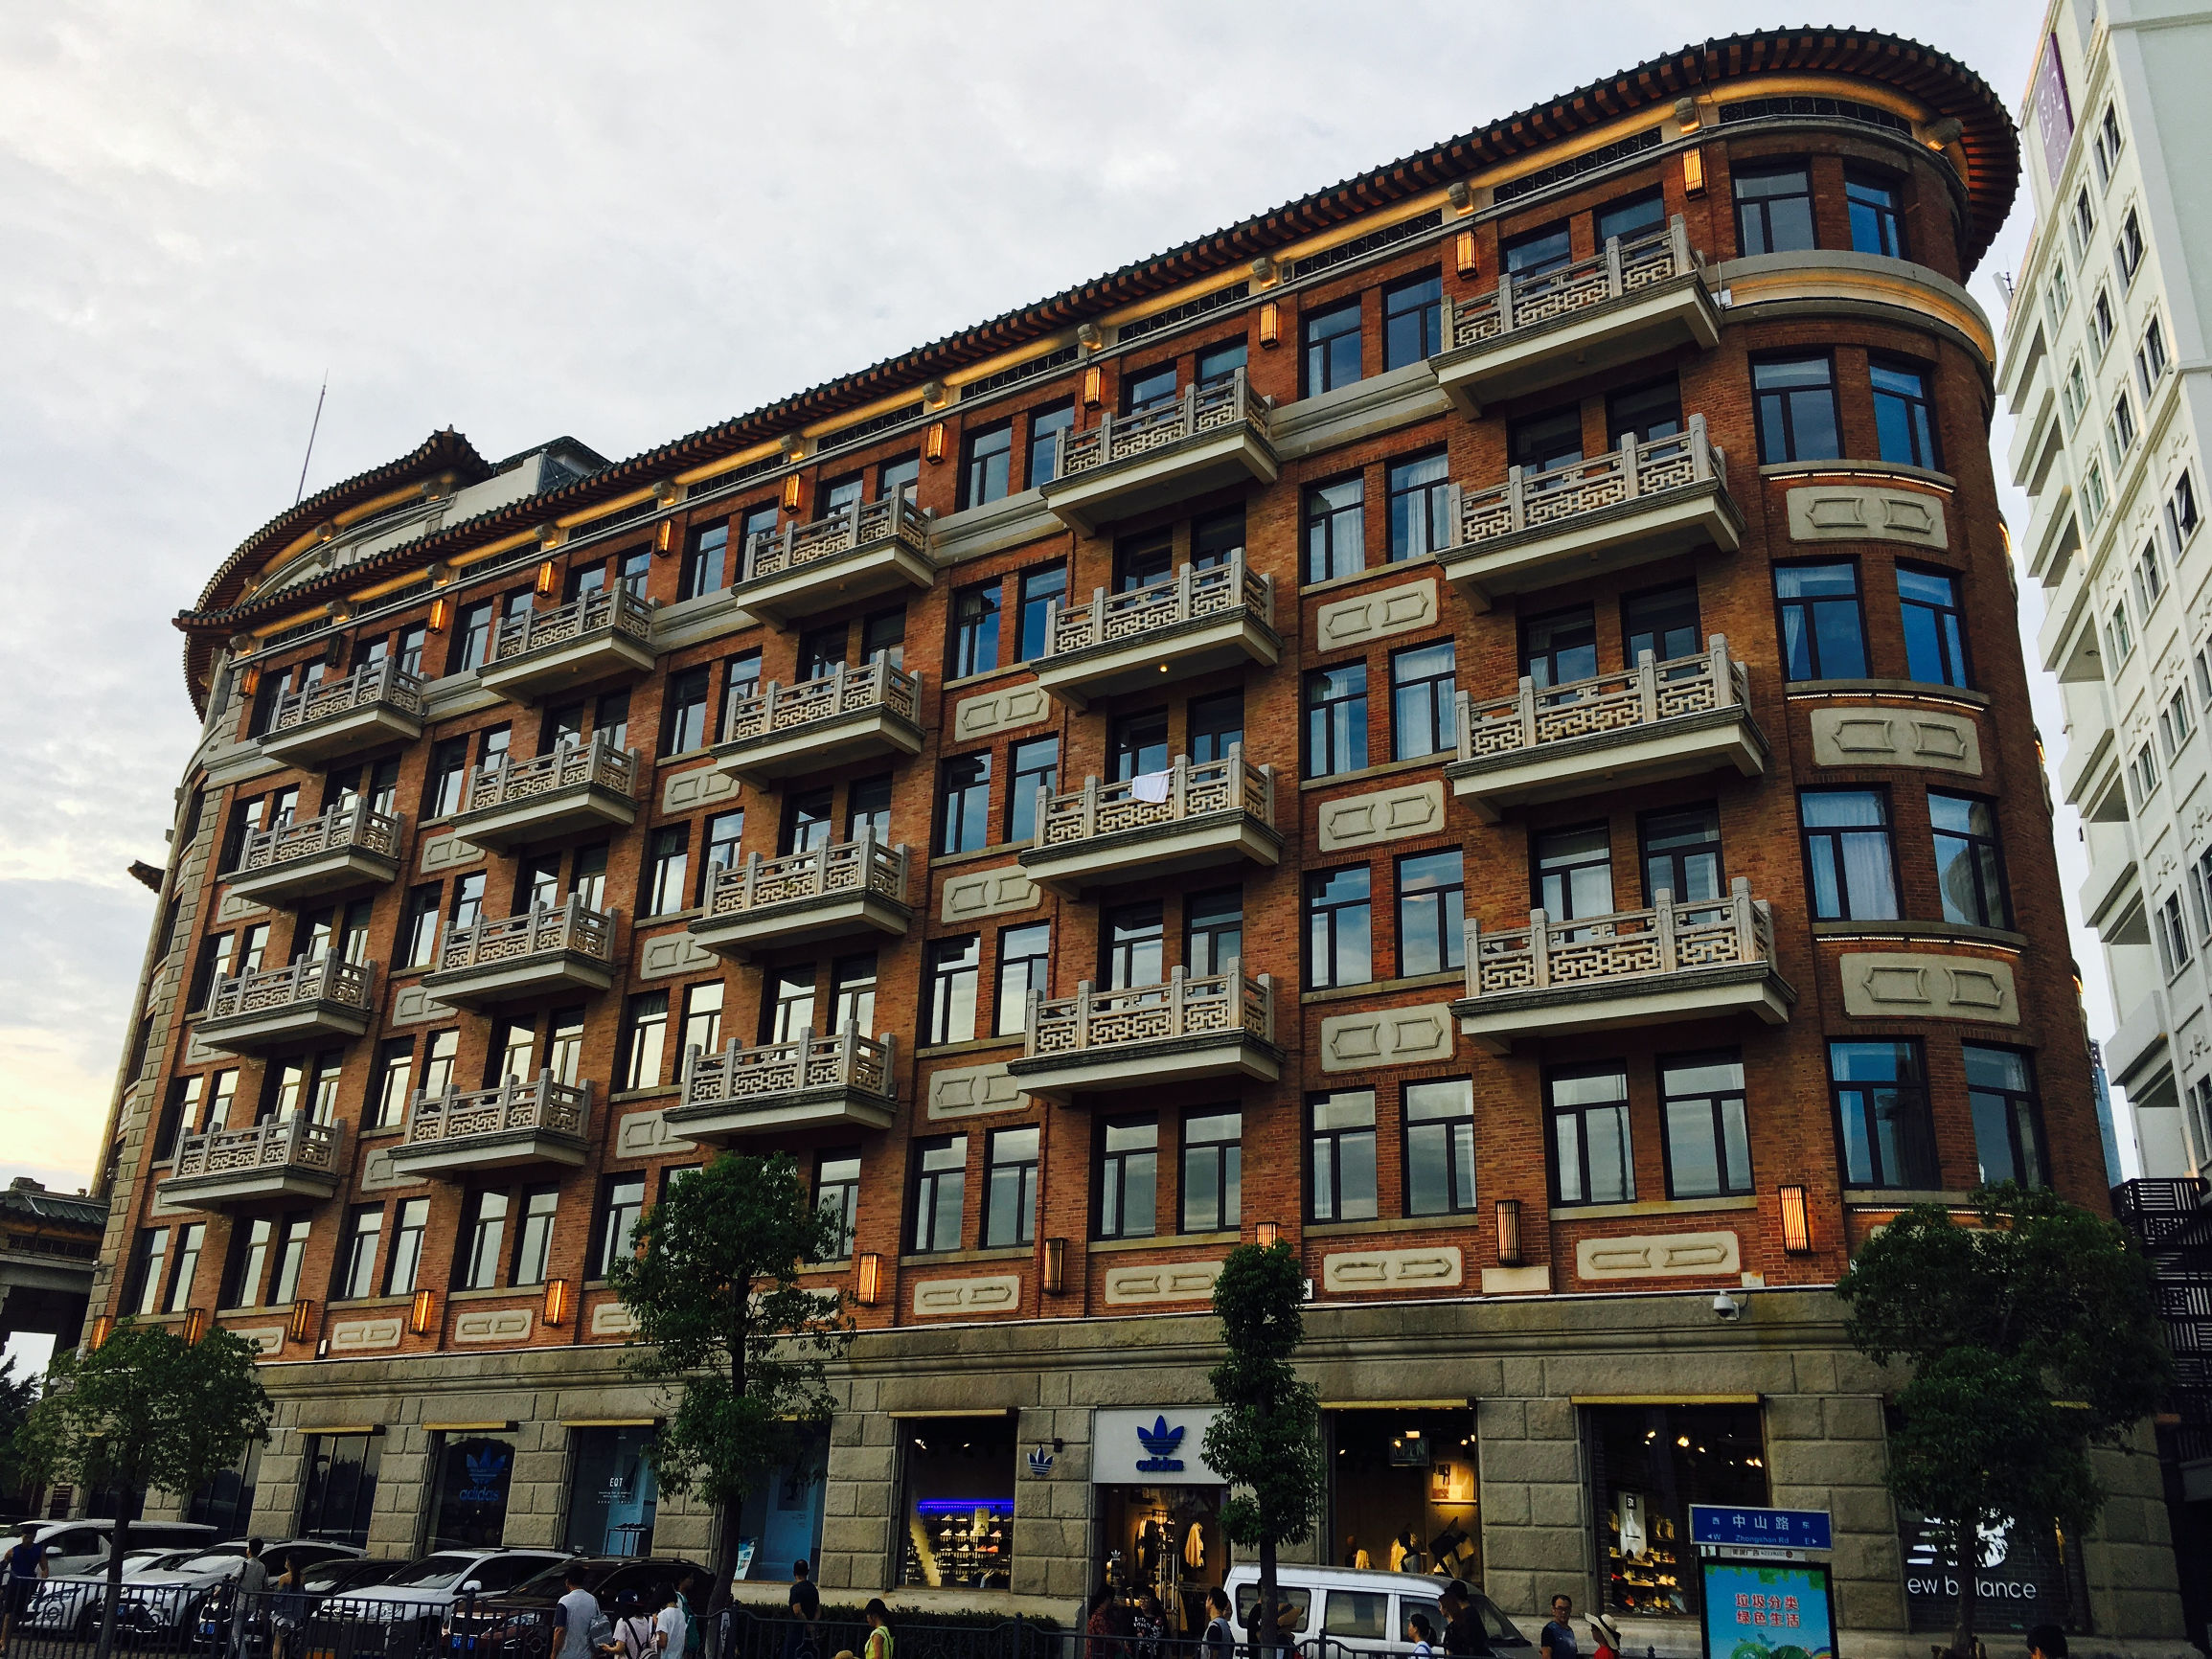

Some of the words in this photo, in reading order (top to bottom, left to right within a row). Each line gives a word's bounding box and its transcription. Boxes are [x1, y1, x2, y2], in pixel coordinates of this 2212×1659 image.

[1395, 1439, 1425, 1456] OPEN
[1136, 1457, 1184, 1472] adidas
[460, 1486, 499, 1502] adidas
[1712, 1516, 1721, 1525] 西
[1732, 1513, 1790, 1531] 中山路
[1802, 1521, 1811, 1530] 东
[1735, 1534, 1777, 1544] Zhongshan
[1907, 1578, 1938, 1594] ew
[1944, 1575, 2038, 1600] blance
[1735, 1593, 1800, 1610] 垃圾分类
[1736, 1610, 1801, 1627] 绿色生活
